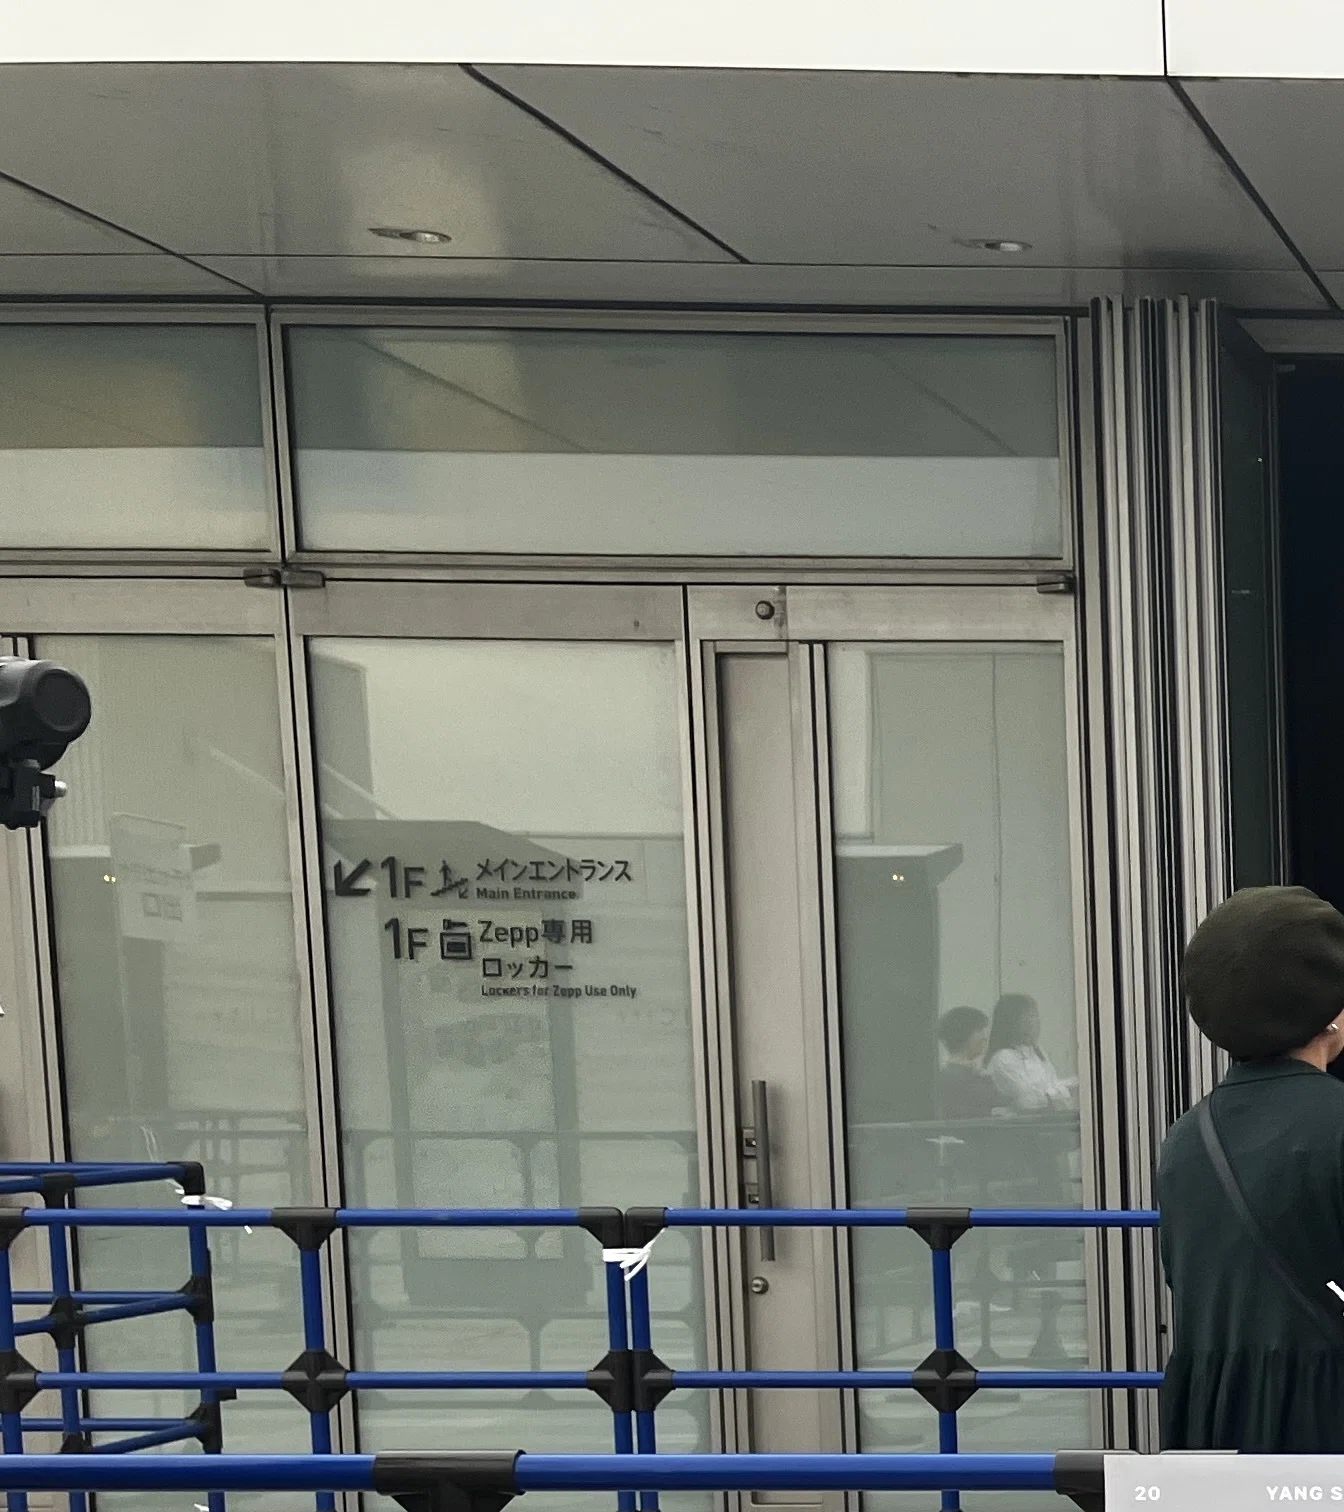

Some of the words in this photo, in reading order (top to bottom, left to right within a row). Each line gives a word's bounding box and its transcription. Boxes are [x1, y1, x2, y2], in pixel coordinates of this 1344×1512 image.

[380, 856, 425, 899] 1F
[476, 858, 633, 882] メインエントランス
[476, 887, 509, 899] Main
[513, 887, 577, 899] Entrance
[385, 918, 429, 961] 1F
[478, 919, 592, 949] Zepp専用
[482, 955, 573, 979] ロッカー
[481, 985, 530, 997] Lockers
[532, 985, 549, 997] for
[553, 985, 582, 999] Zepp
[585, 985, 607, 997] Use
[610, 985, 637, 999] Only
[1135, 1486, 1161, 1500] 20
[1267, 1486, 1322, 1500] YANG
